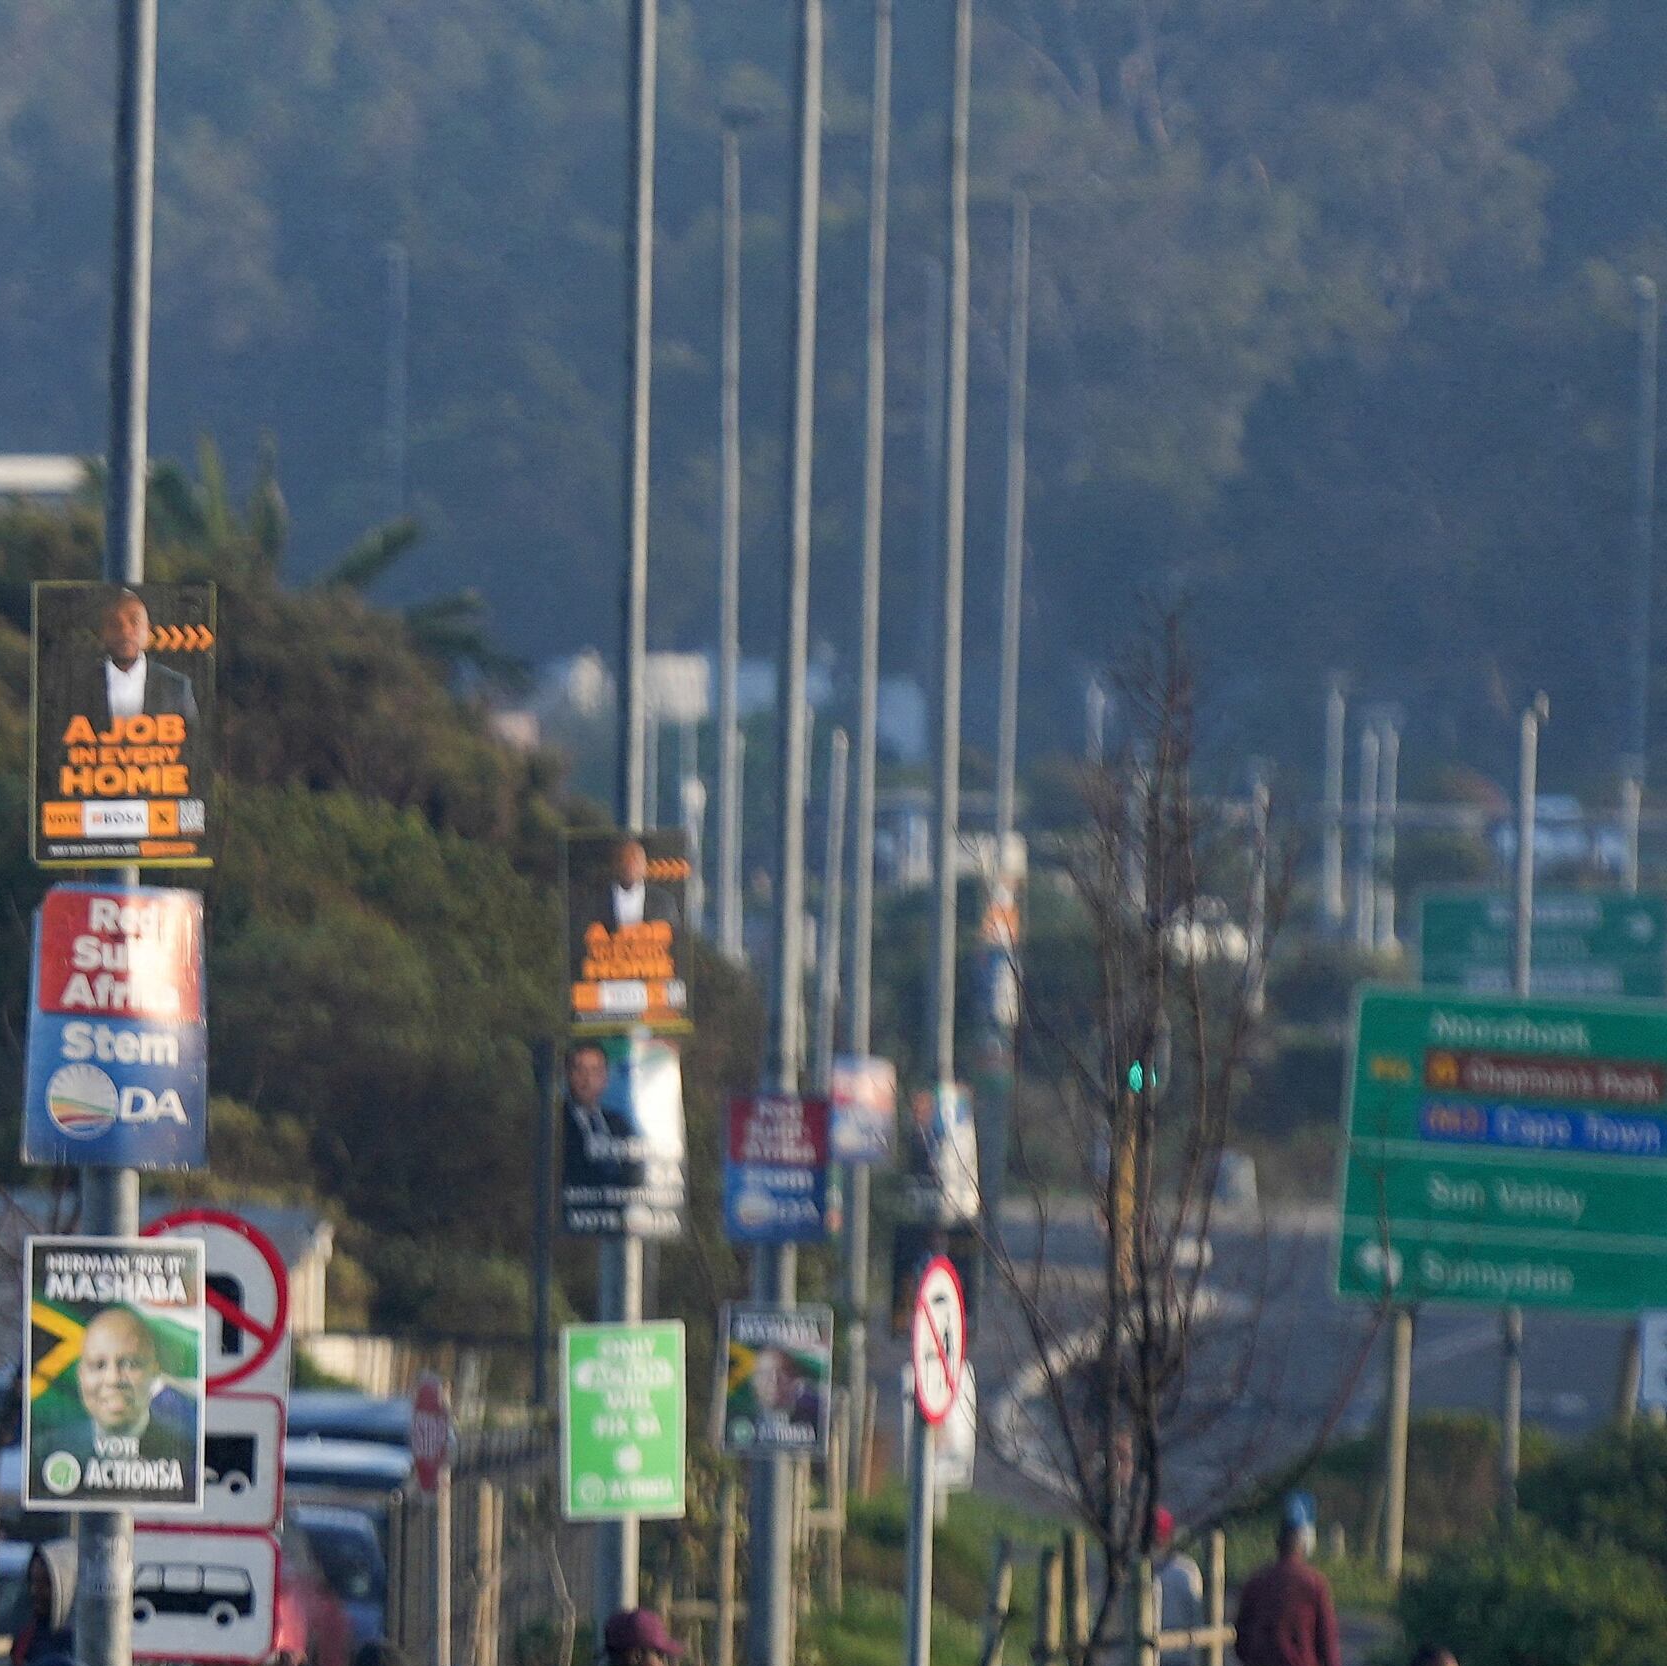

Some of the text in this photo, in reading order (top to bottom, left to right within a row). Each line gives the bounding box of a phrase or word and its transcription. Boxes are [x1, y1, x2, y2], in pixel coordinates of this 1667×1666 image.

[63, 713, 187, 745] A JOB
[69, 745, 181, 764] IN EVERY
[60, 764, 190, 796] HOME
[61, 1021, 179, 1065] Stem
[119, 1086, 188, 1125] DA
[1495, 1105, 1571, 1144] Cape
[1585, 1111, 1661, 1148] Town
[44, 1272, 187, 1302] MASHABA
[94, 1437, 140, 1458] VOTE
[84, 1458, 184, 1490] ACTIONSA
